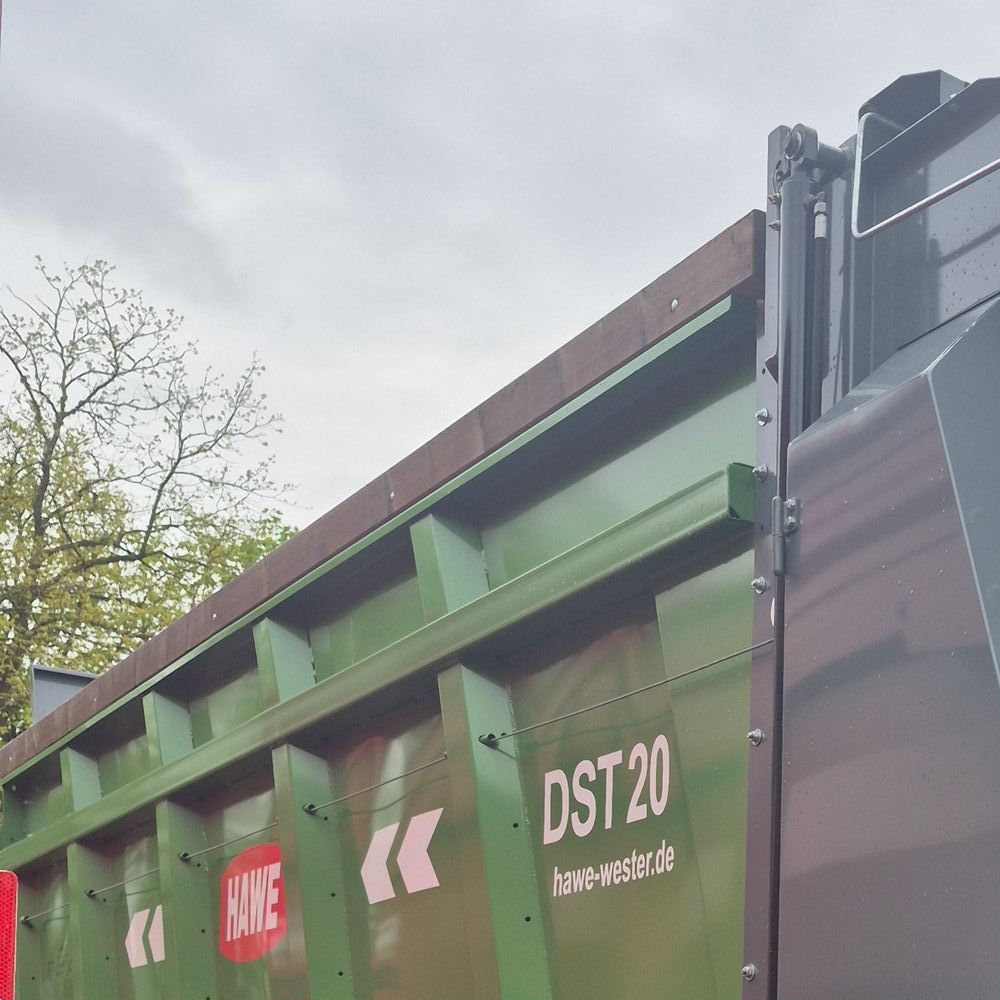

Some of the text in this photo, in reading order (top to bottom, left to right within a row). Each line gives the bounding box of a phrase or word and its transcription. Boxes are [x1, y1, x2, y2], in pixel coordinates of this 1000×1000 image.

[543, 734, 670, 845] DST 20
[226, 861, 281, 942] HAWE
[553, 839, 675, 897] hawe-wester.de
